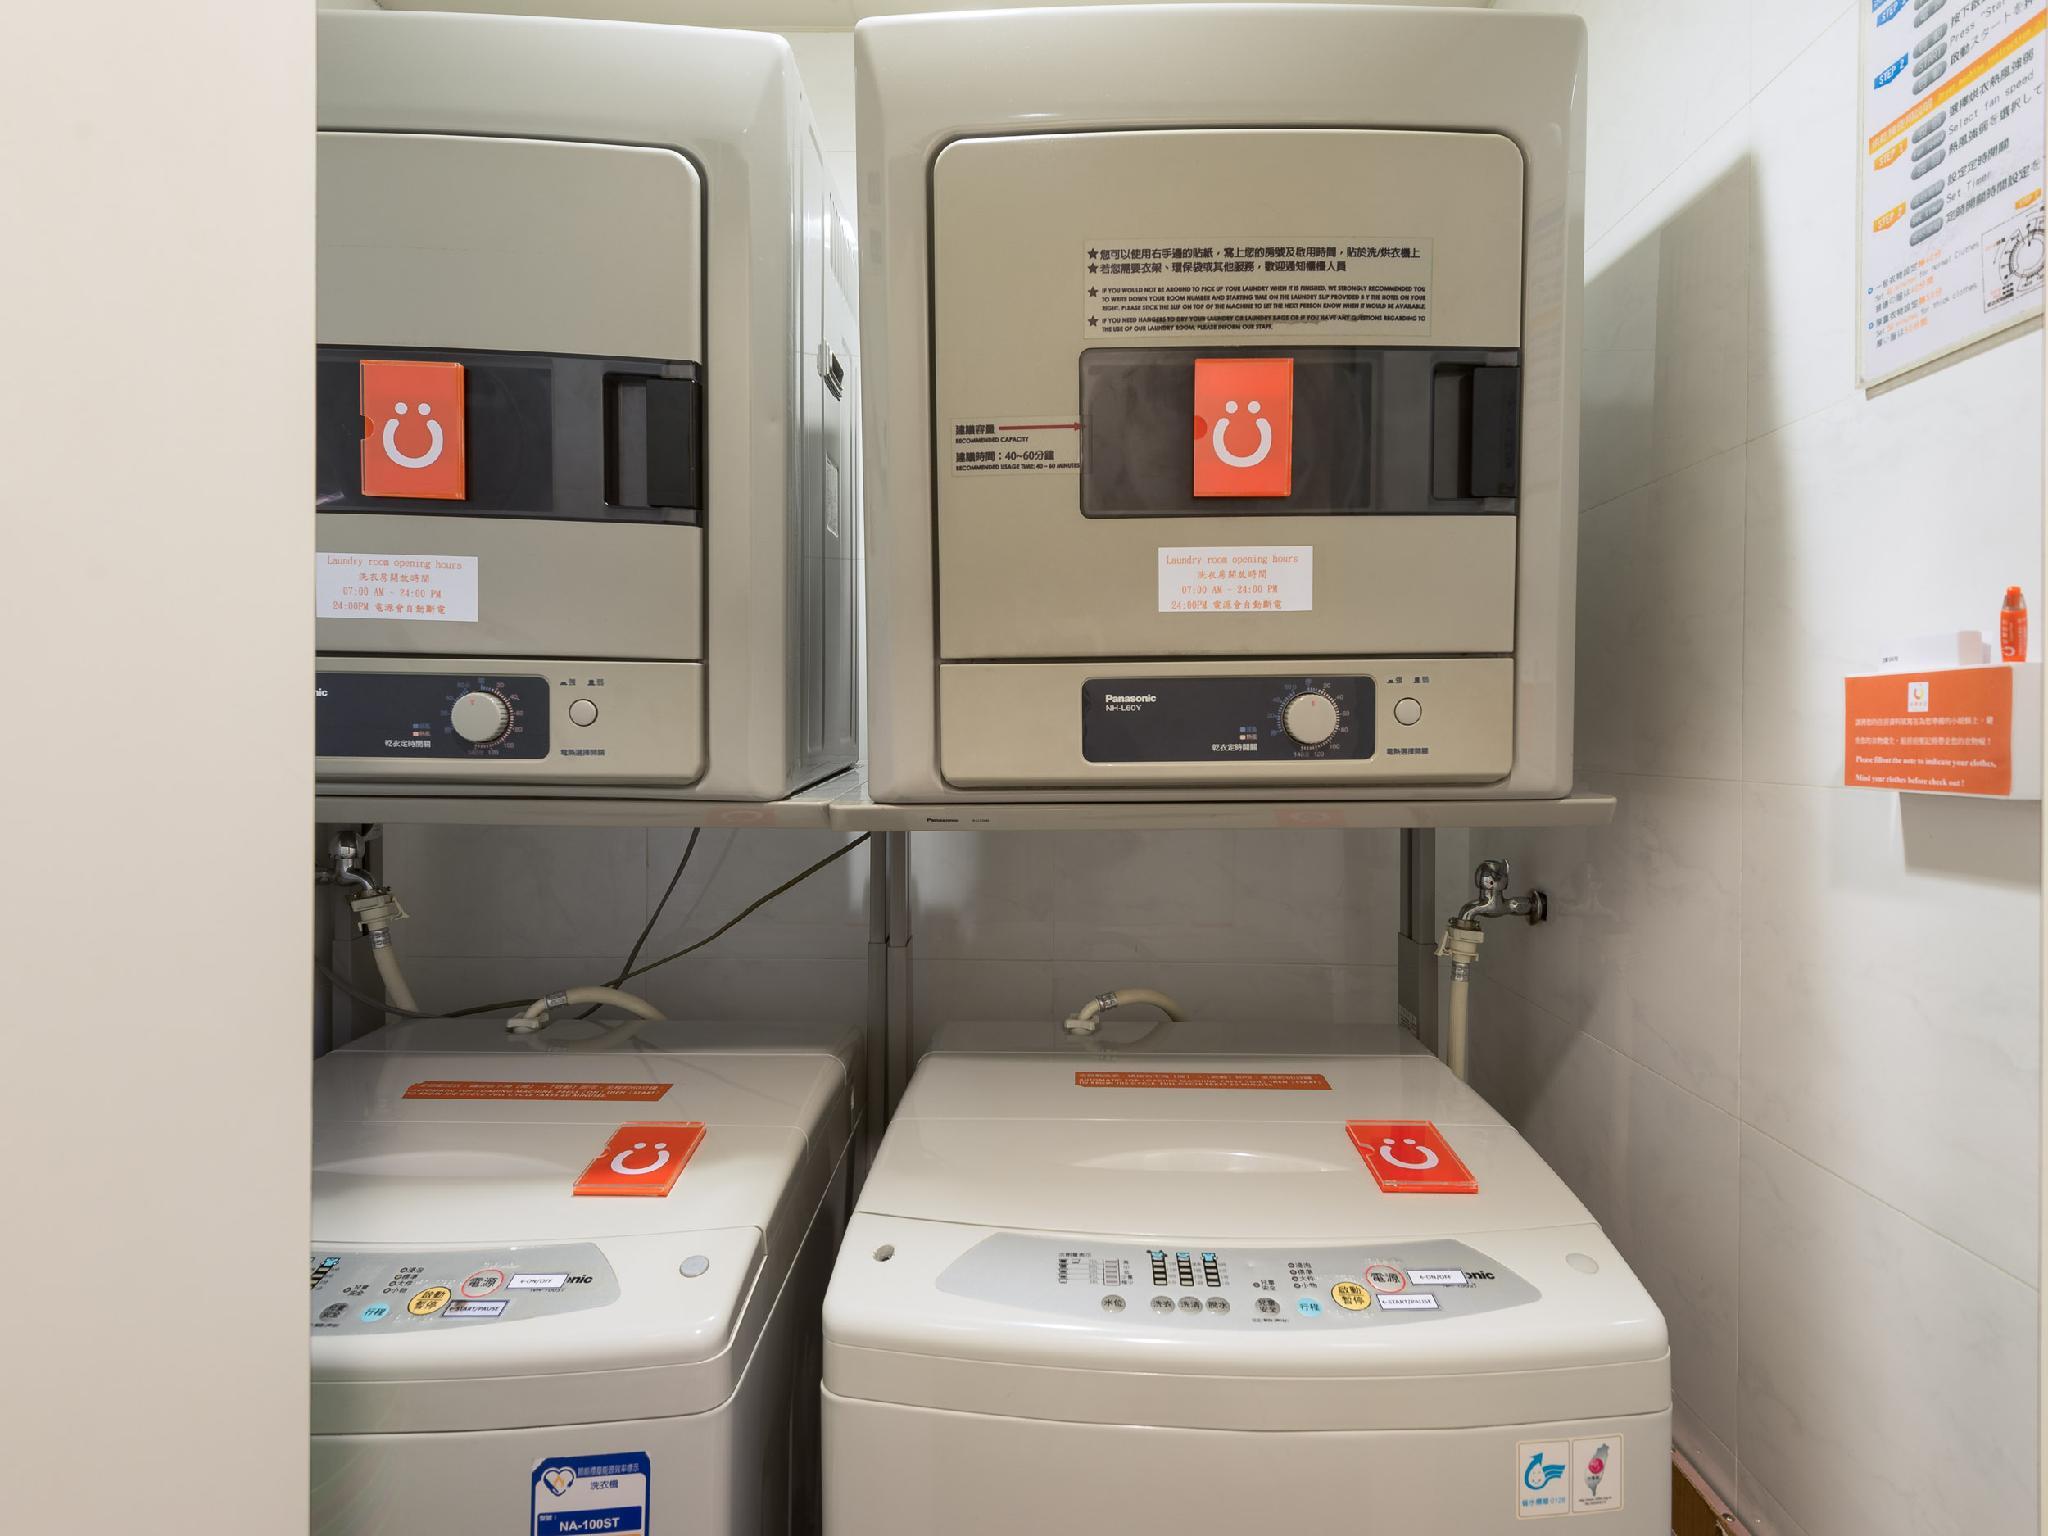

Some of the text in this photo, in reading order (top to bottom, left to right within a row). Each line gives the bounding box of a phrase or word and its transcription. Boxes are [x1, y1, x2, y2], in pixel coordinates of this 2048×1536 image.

[1879, 65, 1897, 85] STEP
[1949, 109, 1978, 134] Select
[2004, 68, 2034, 96] speed
[1946, 188, 1961, 204] Set
[327, 556, 463, 569] Laundry room opening hours
[1166, 554, 1298, 565] Laundry room opening hours
[343, 586, 369, 597] 07:00
[431, 588, 442, 598] PM
[1212, 585, 1222, 594] AM
[1237, 584, 1263, 593] 24:00
[1267, 584, 1278, 593] PM
[1105, 693, 1157, 703] Panasonic
[1855, 755, 1873, 763] Please
[1925, 757, 1952, 766] indicate
[1952, 760, 1969, 768] your
[1855, 774, 1871, 782] Mind
[1872, 776, 1885, 784] your
[1908, 777, 1928, 785] before
[1928, 778, 1947, 787] check
[467, 1277, 499, 1288] 電源
[1371, 1272, 1401, 1283] 電源
[559, 1516, 620, 1532] NA-100ST
